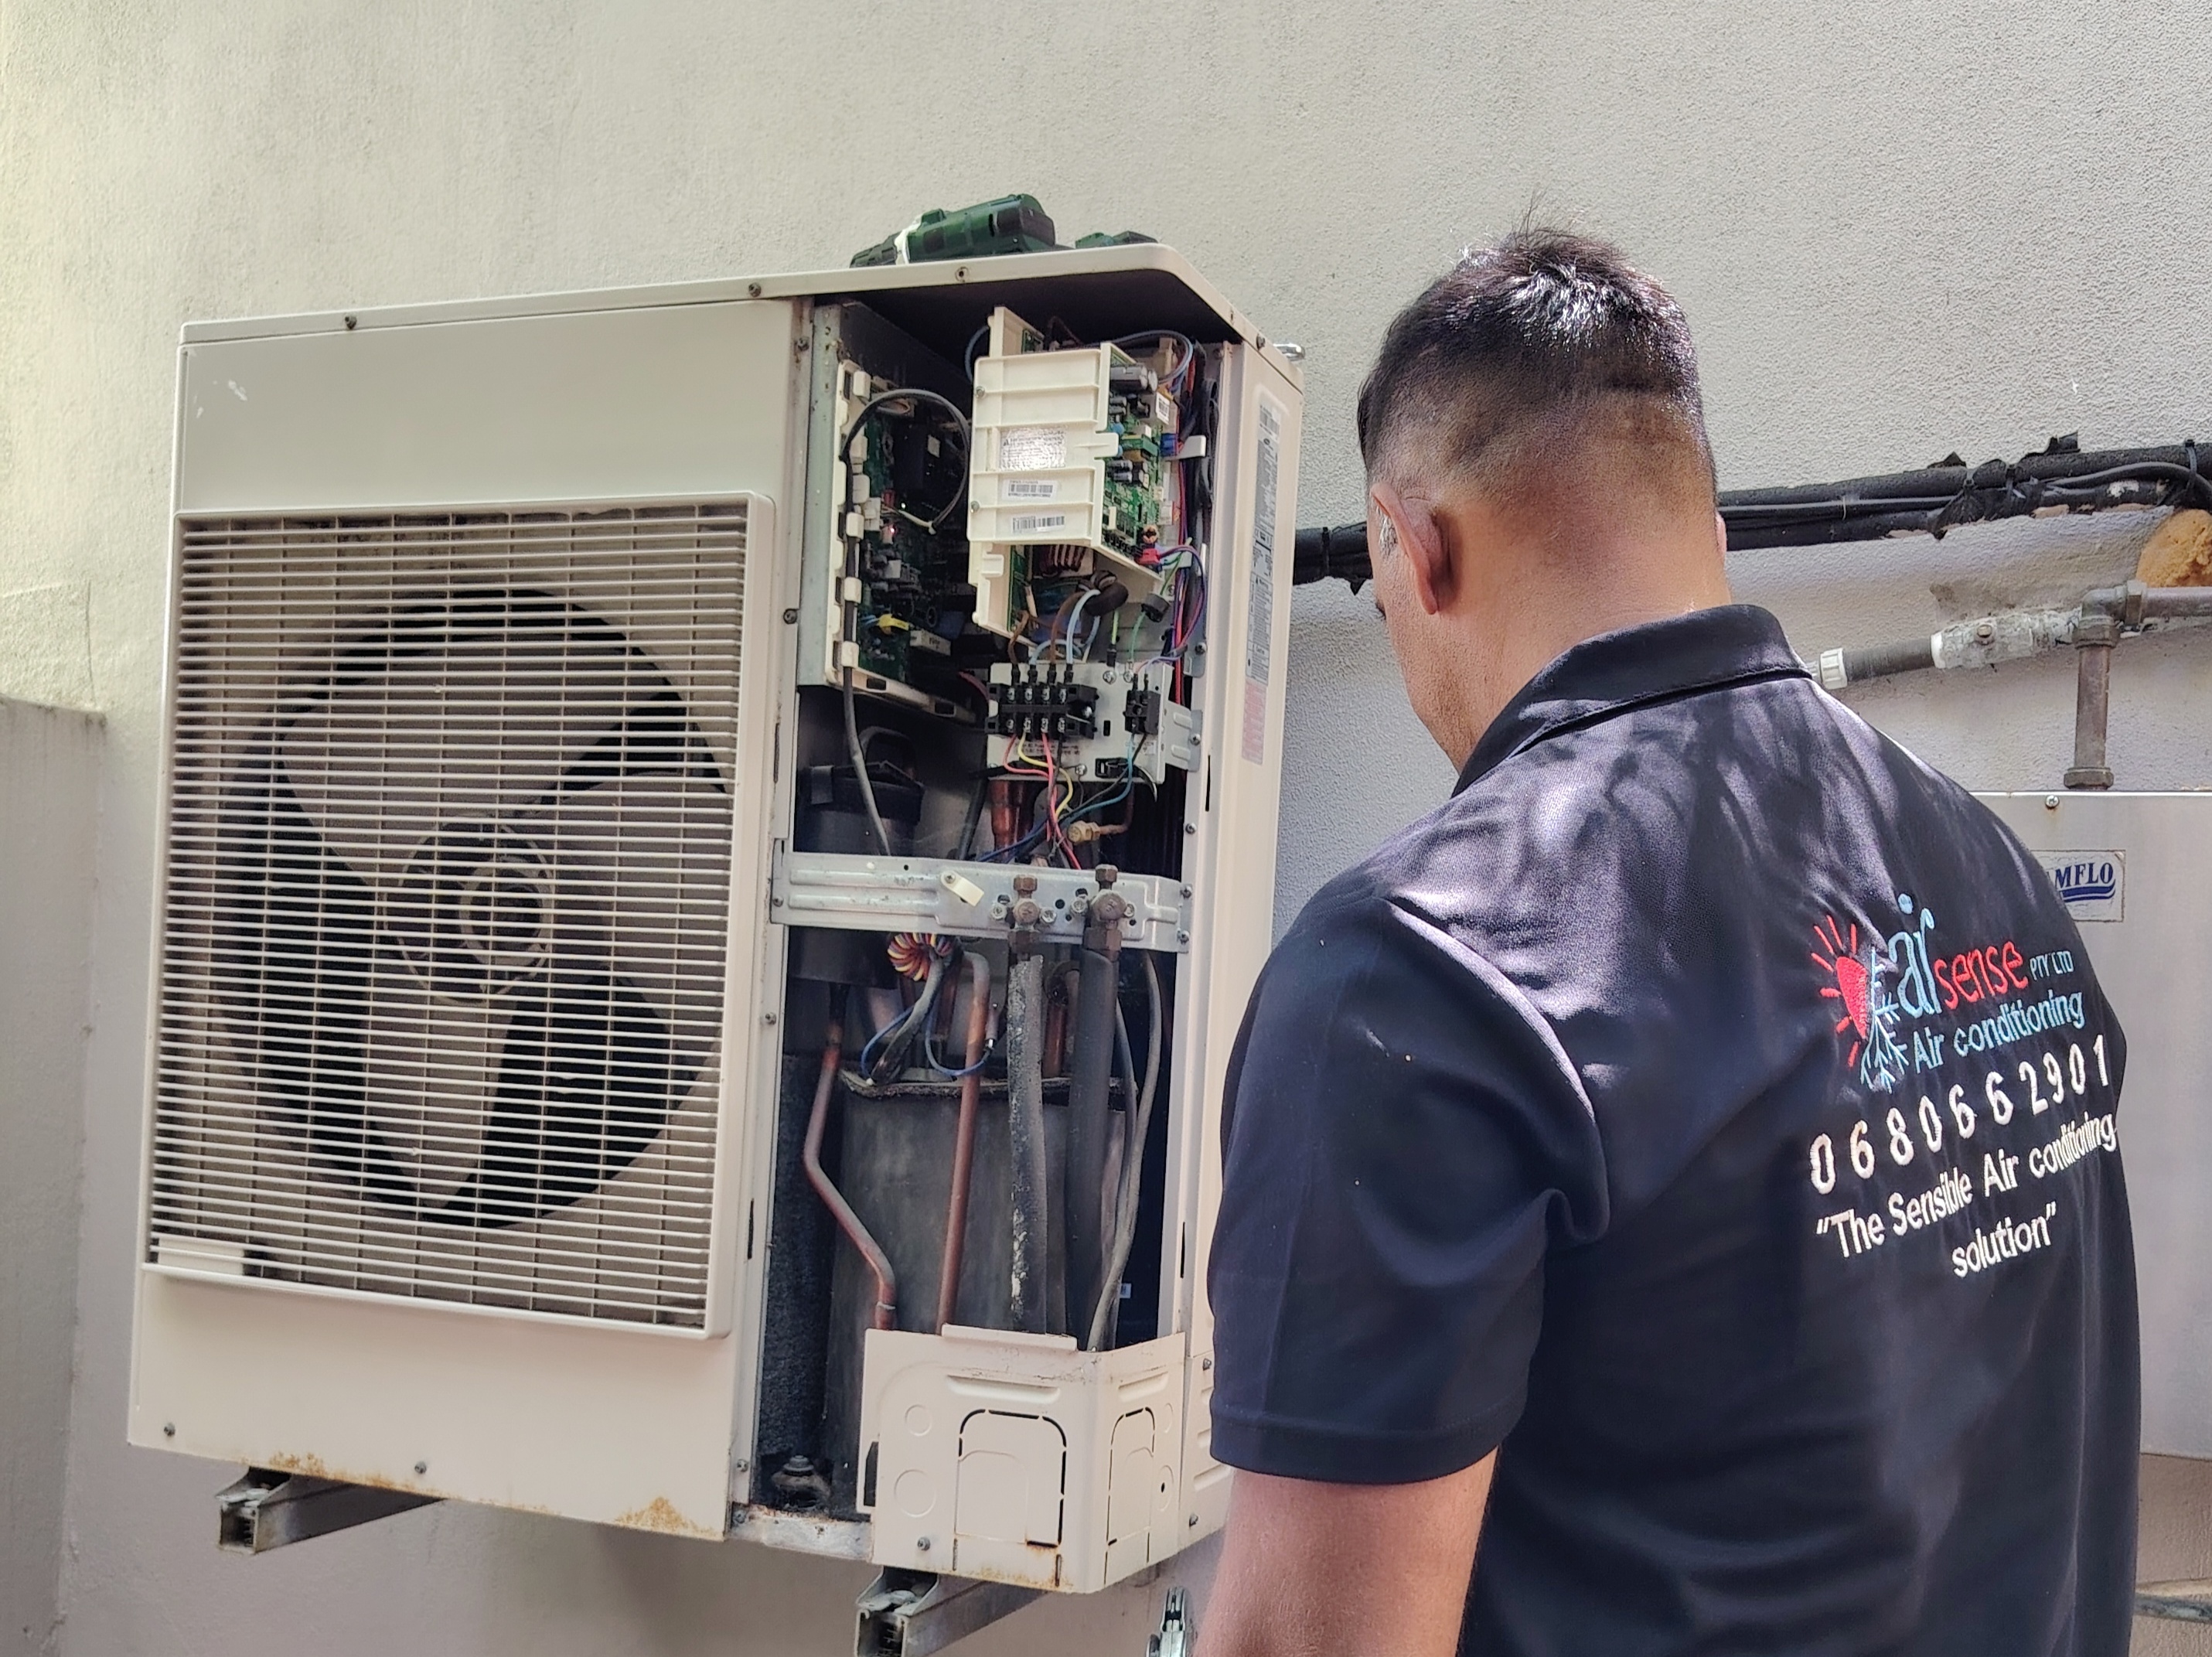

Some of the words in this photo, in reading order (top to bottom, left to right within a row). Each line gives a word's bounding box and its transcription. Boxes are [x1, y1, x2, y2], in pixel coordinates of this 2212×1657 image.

[2047, 862, 2113, 889] MFLO
[2029, 953, 2050, 980] PTY
[2050, 950, 2074, 974] LTD
[1913, 1027, 1945, 1074] Air
[1954, 989, 2085, 1057] conditioning
[1888, 1166, 1973, 1236] Sensible
[1982, 1148, 2019, 1198] Air
[2030, 1112, 2117, 1178] conditioning
